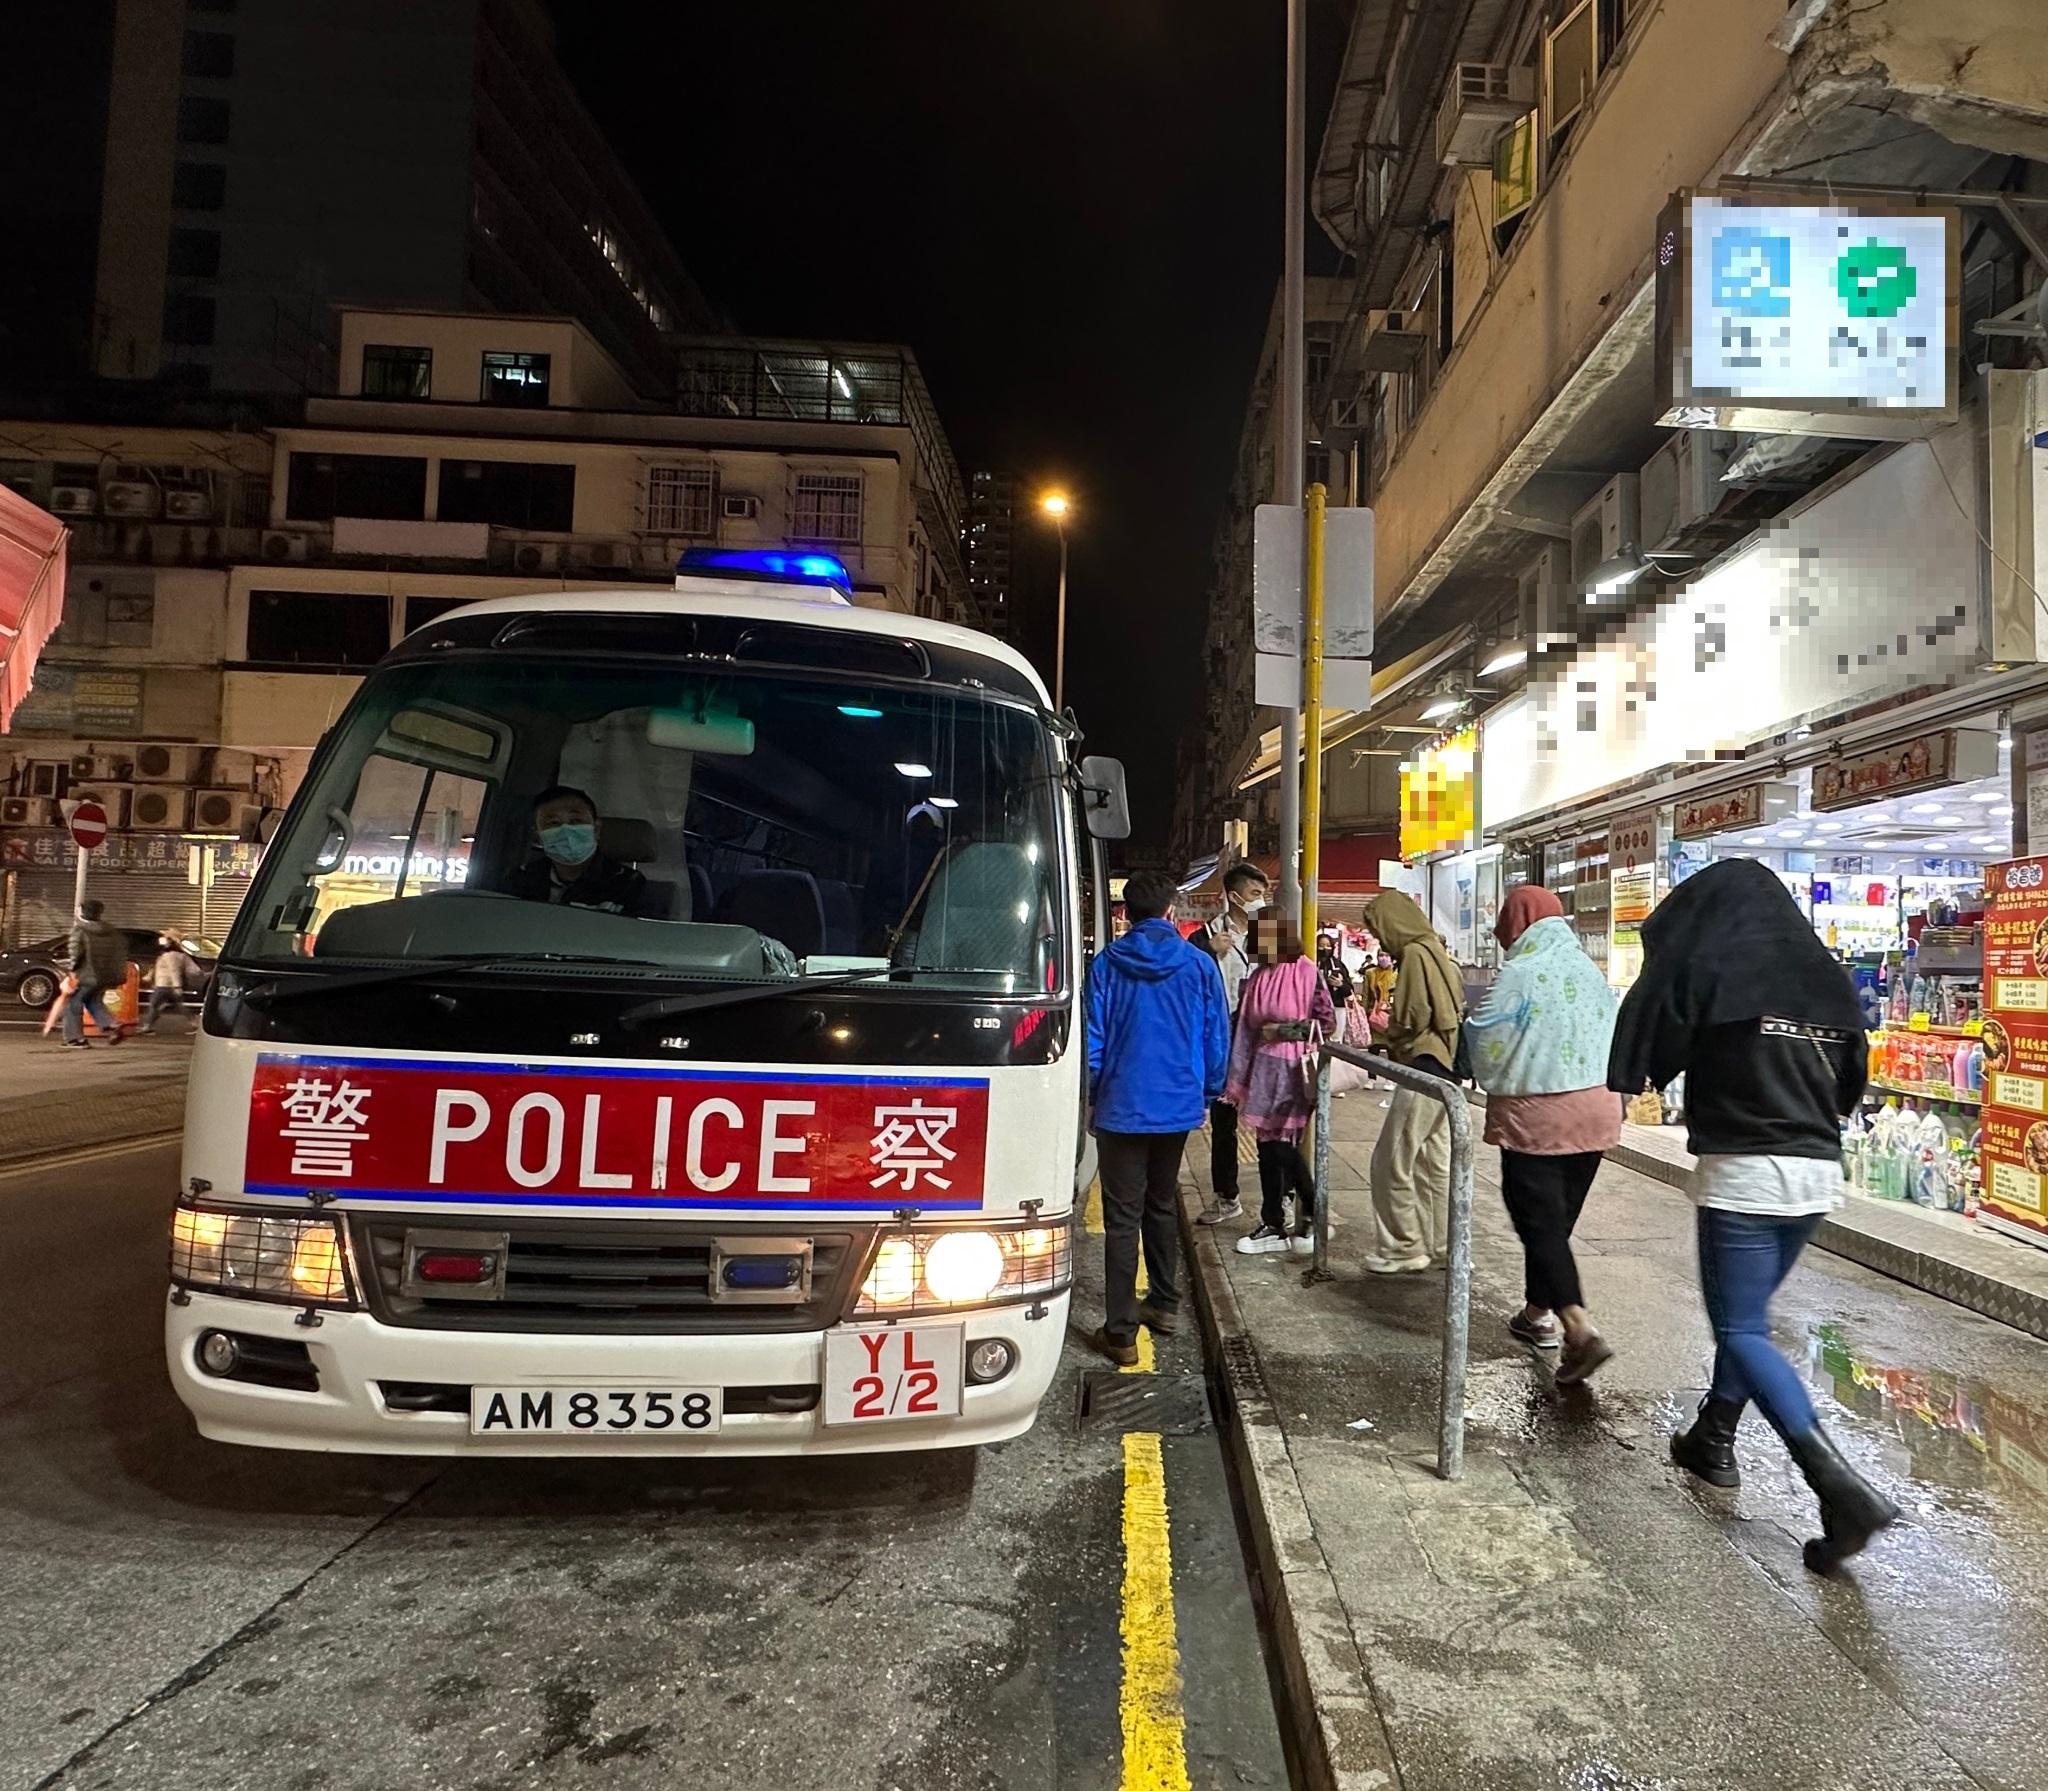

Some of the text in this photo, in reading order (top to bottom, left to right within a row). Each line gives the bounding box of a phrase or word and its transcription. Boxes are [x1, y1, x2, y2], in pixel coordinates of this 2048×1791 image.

[63, 856, 80, 867] B
[90, 857, 129, 868] FOOD
[138, 858, 254, 871] SUPERRKET
[280, 1079, 958, 1193] 警 POLICE 察
[482, 1392, 712, 1430] AM 8358
[852, 1371, 939, 1418] 2/2
